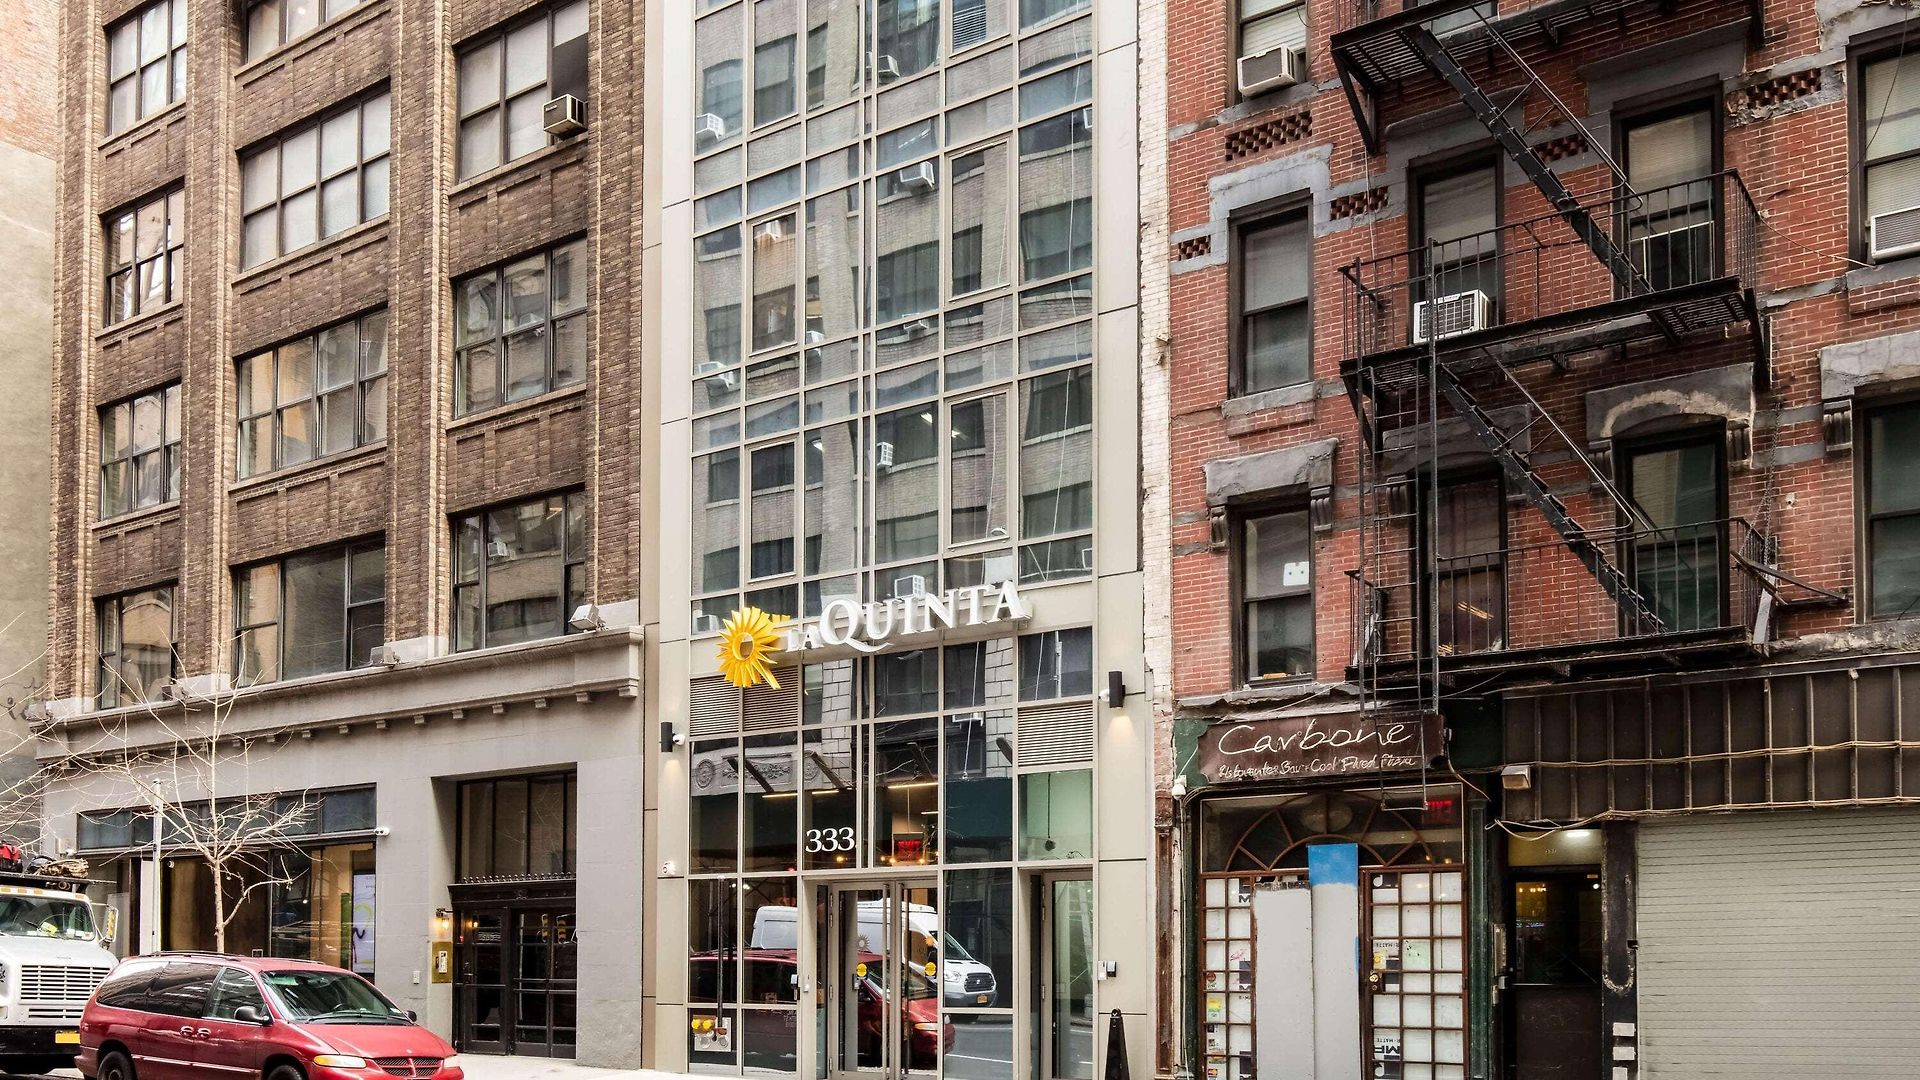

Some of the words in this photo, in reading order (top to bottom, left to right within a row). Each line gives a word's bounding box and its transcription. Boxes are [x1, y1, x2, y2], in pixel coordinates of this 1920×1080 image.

[786, 624, 824, 653] LA
[821, 580, 1031, 652] QUINTA
[1218, 719, 1413, 754] Carbone
[805, 826, 856, 853] 333
